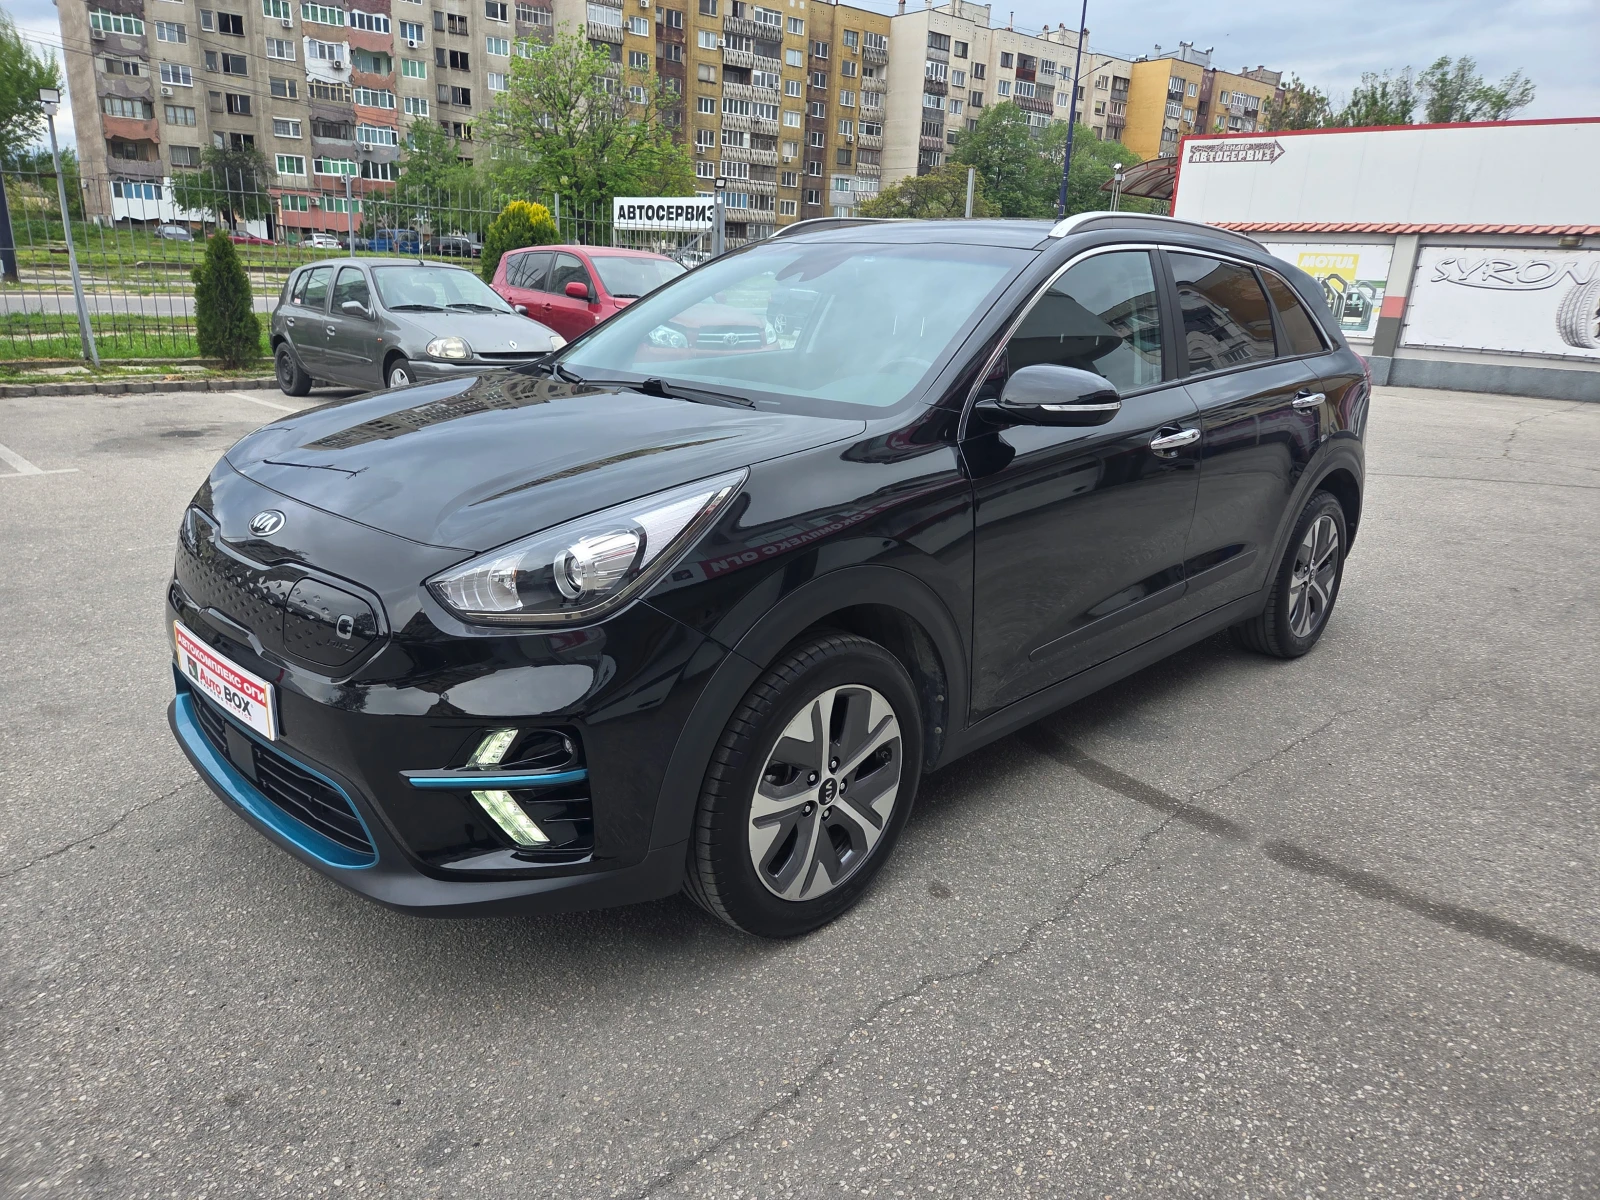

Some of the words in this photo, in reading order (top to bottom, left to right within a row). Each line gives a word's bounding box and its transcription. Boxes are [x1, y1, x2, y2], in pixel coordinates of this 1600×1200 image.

[1192, 149, 1272, 162] АВТОСЕРВИЗ
[617, 204, 714, 222] АВТОСЕРВИЗ
[1300, 255, 1355, 269] MOTUL
[1431, 257, 1600, 286] SYRON
[250, 511, 278, 532] KIA
[177, 633, 242, 688] АВТОКОМПЛЕКС
[243, 683, 266, 703] ОГИ
[223, 685, 252, 717] BOX
[825, 780, 833, 804] KIA
